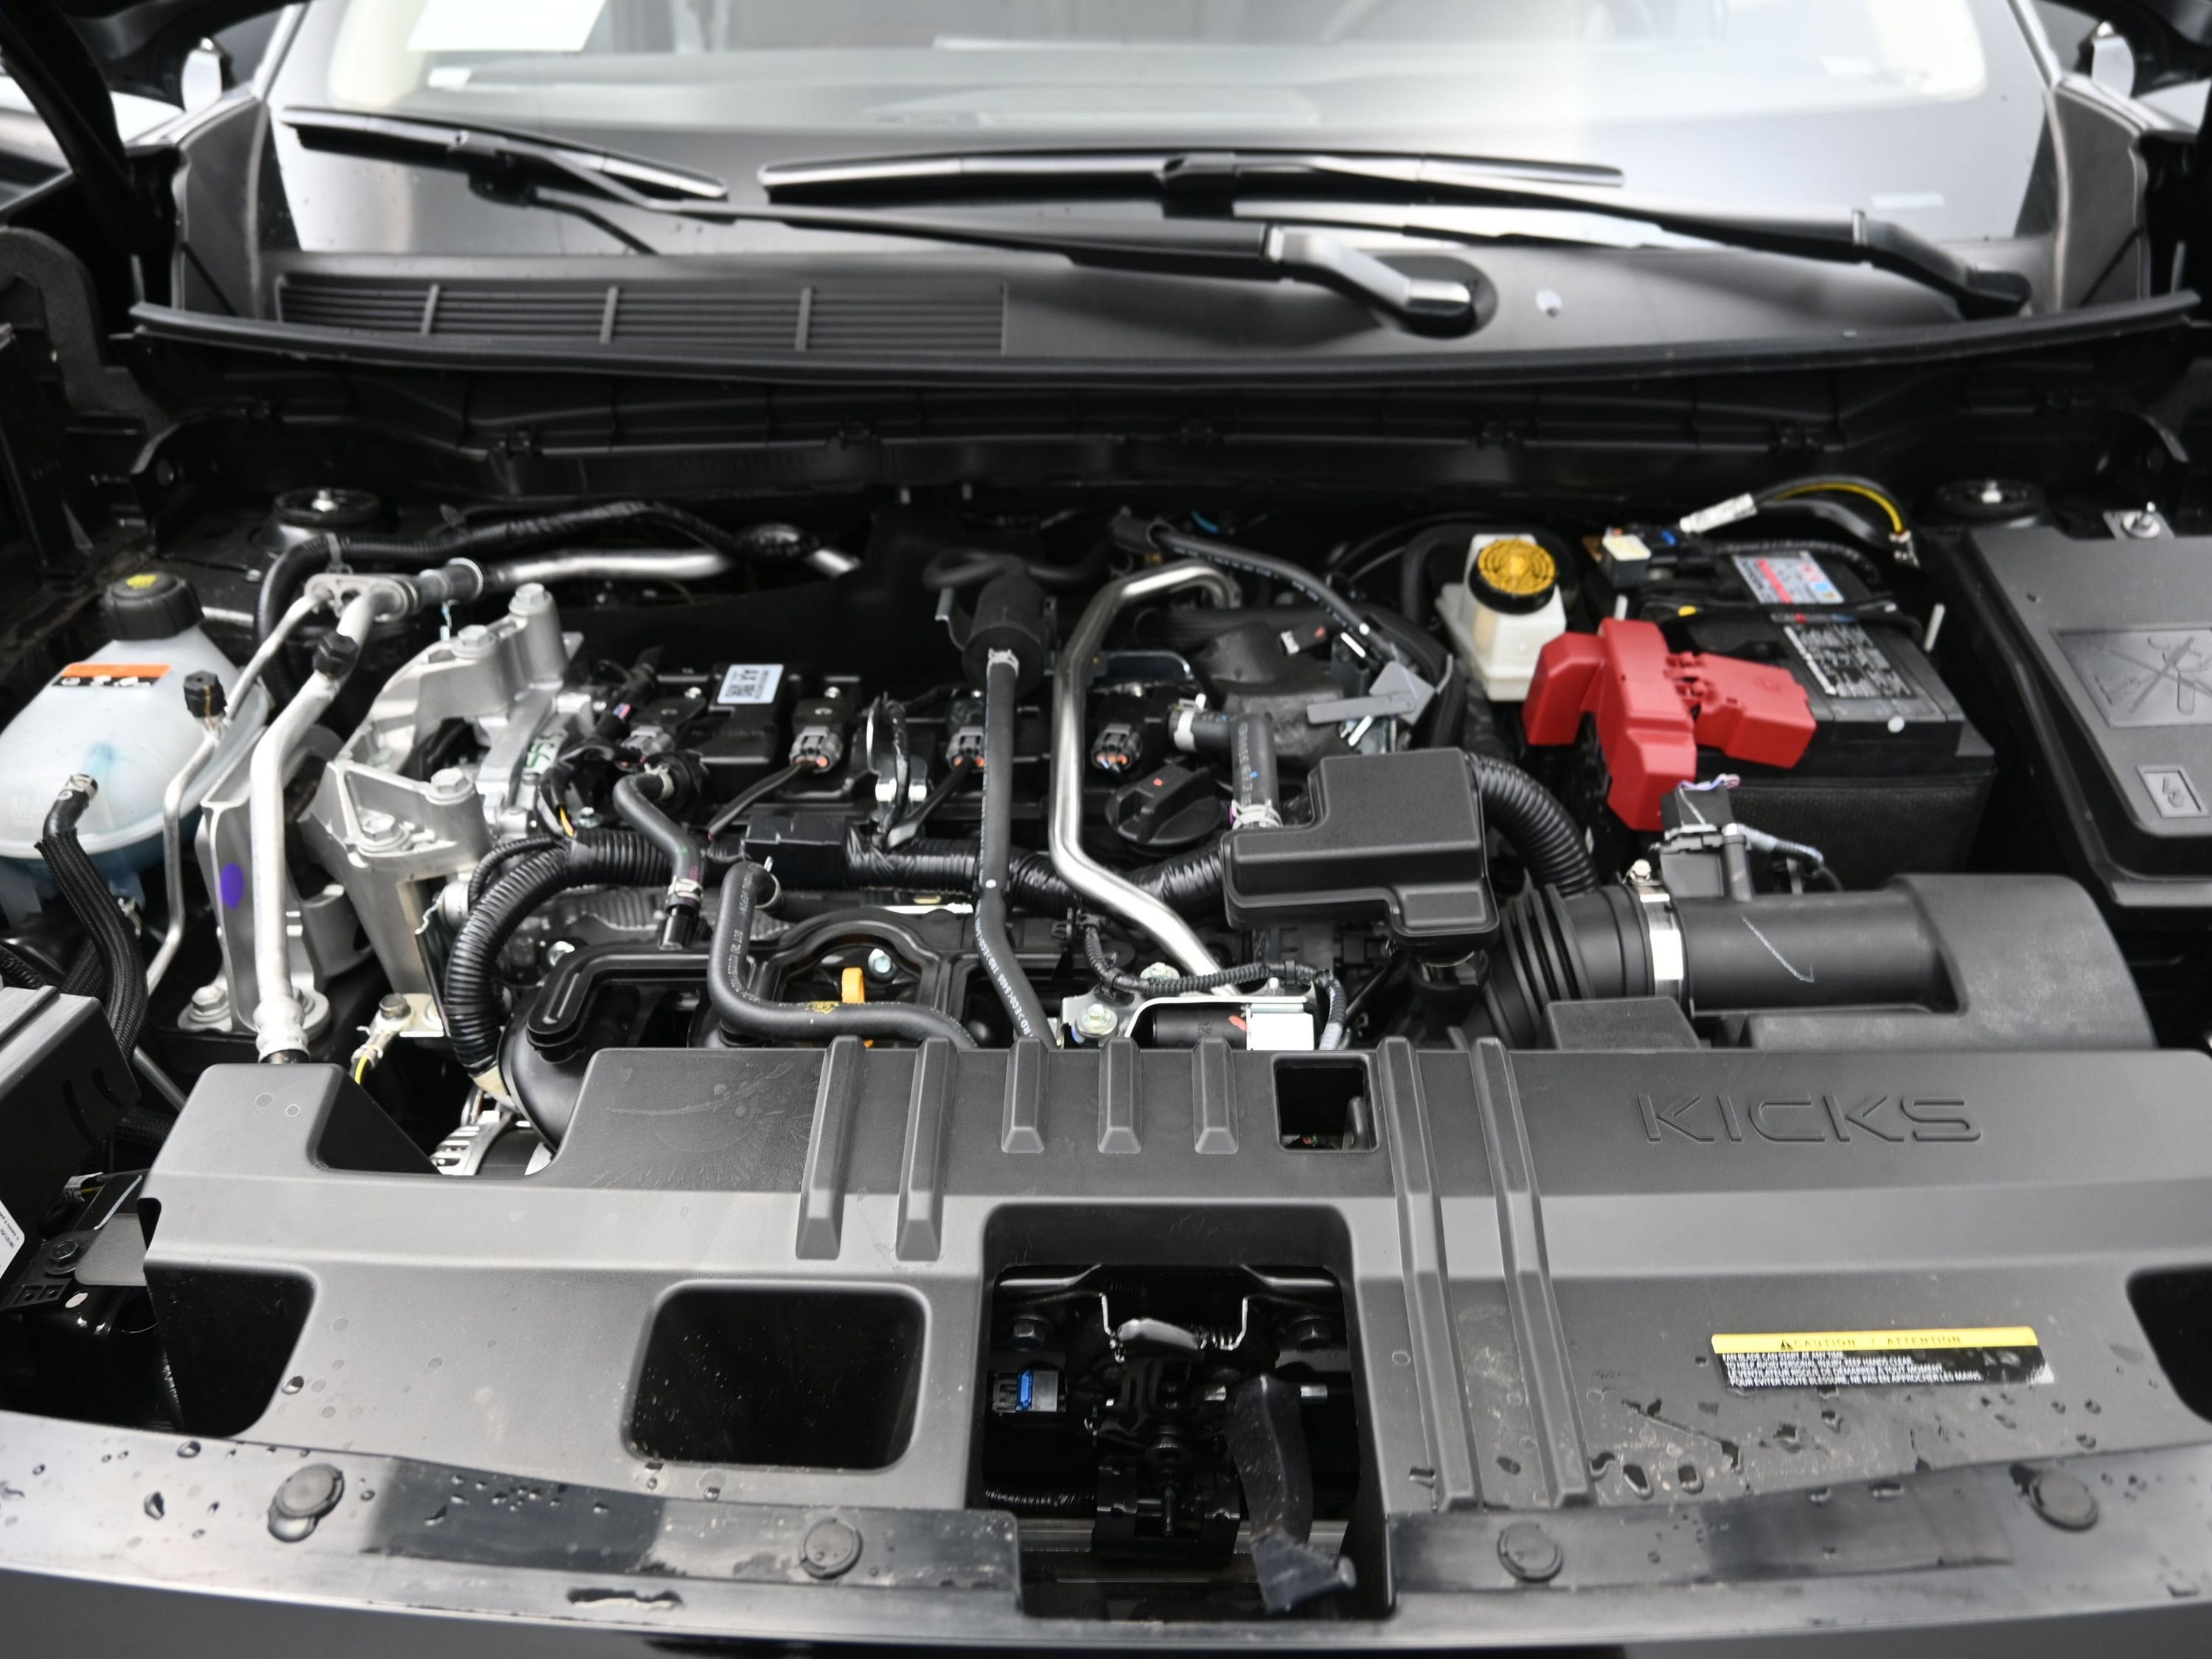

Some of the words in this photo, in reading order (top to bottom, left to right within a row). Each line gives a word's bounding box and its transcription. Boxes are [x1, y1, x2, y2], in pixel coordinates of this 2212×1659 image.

[1636, 1094, 1981, 1142] KICKS
[1794, 1339, 1856, 1347] CAUTION
[1888, 1336, 1961, 1346] ATTENTION
[1722, 1354, 1737, 1363] FAN
[1761, 1352, 1778, 1361] CAN
[1778, 1352, 1801, 1360] START
[1811, 1351, 1829, 1360] ANY
[1736, 1362, 1756, 1371] HELP
[1756, 1361, 1780, 1370] AVOID
[1779, 1360, 1818, 1369] PERSONAL
[1884, 1365, 1907, 1374] TOUT
[1730, 1378, 1755, 1388] POUR
[1781, 1376, 1809, 1385] TOUTE
[1862, 1374, 1879, 1384] PAS
[1878, 1374, 1891, 1383] EN
[1891, 1372, 1940, 1383] APPROCHER
[1939, 1371, 1955, 1381] LES
